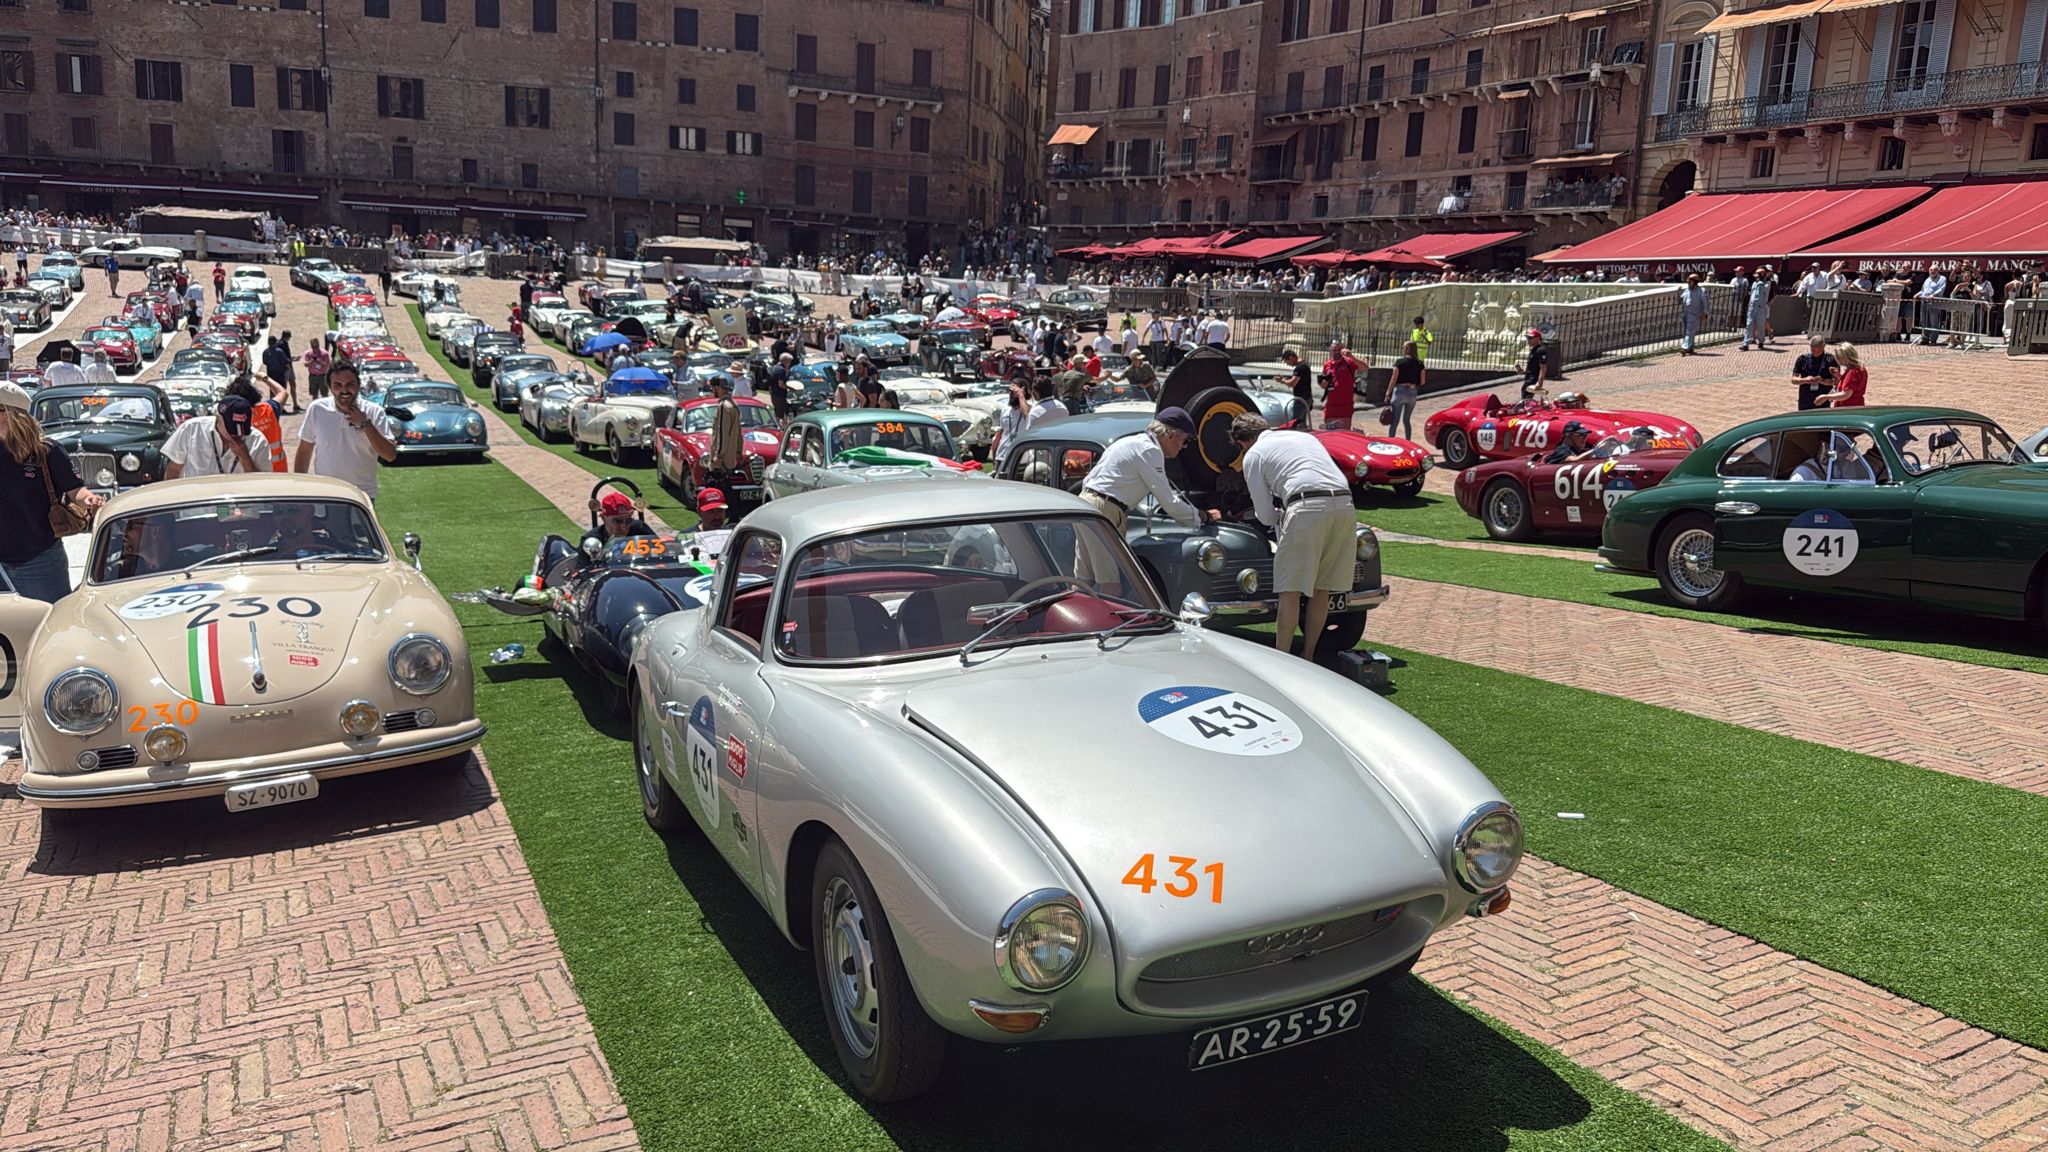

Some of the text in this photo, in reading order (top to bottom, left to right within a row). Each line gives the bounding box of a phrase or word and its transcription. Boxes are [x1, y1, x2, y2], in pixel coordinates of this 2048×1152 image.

[352, 205, 389, 213] RISTORANTE
[440, 209, 457, 217] GAIA
[1215, 259, 1255, 268] RISTORANTE
[1656, 263, 1668, 273] AL
[1675, 262, 1715, 273] MANGIA
[877, 422, 905, 433] 384
[1514, 420, 1550, 449] 728
[1480, 432, 1493, 443] 148
[1649, 438, 1671, 449] 240
[1393, 458, 1413, 468] 390
[1555, 463, 1603, 500] 614
[623, 539, 666, 555] 453
[1796, 535, 1845, 558] 241
[128, 594, 207, 610] 230
[187, 597, 322, 629] 230
[128, 699, 199, 733] 230
[1187, 701, 1278, 740] 431
[729, 739, 744, 758] 1000
[692, 743, 716, 801] 431
[1121, 853, 1223, 904] 431
